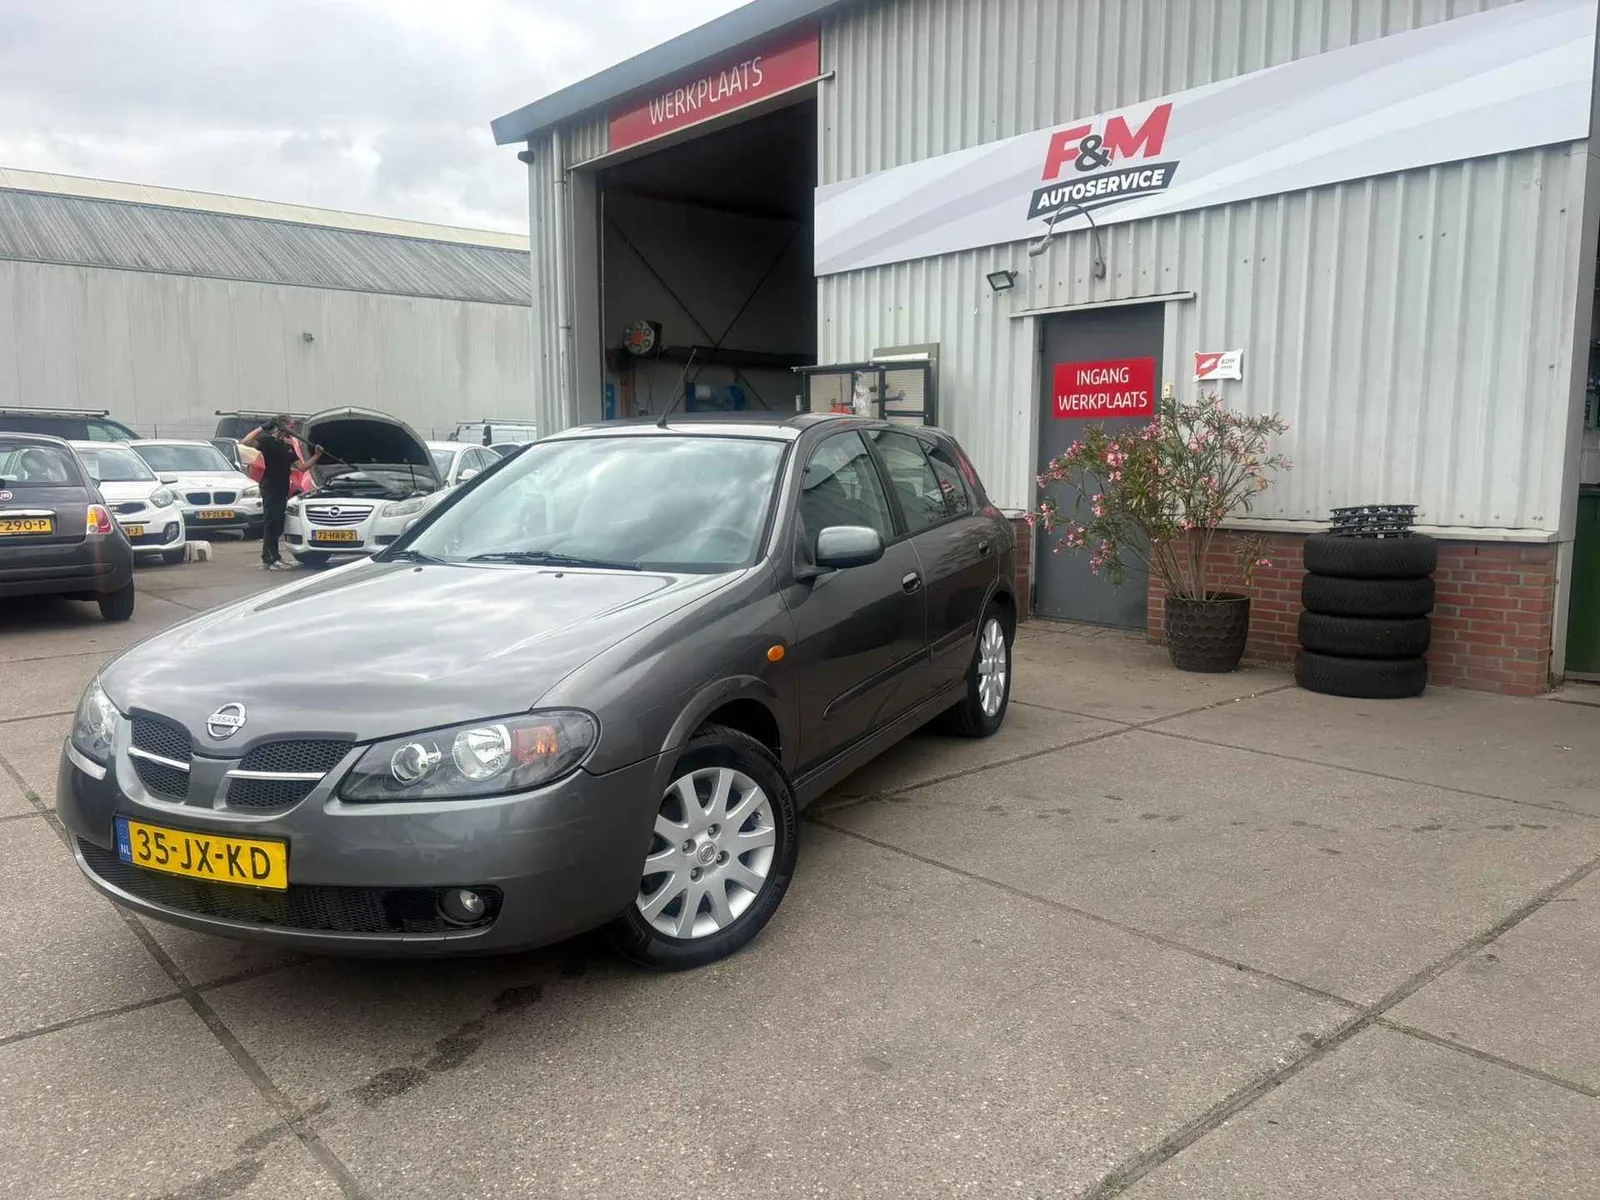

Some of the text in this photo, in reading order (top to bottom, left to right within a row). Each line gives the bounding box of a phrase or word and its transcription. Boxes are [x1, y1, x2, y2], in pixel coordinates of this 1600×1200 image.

[649, 56, 764, 126] WERKPLAATS
[1042, 102, 1173, 182] F&M
[1037, 168, 1165, 210] AUTOSERVICE
[1076, 366, 1130, 387] INGANG
[1058, 390, 1148, 411] WERKPLAATS
[120, 843, 131, 855] NL
[136, 828, 271, 880] 35-JX-KD
